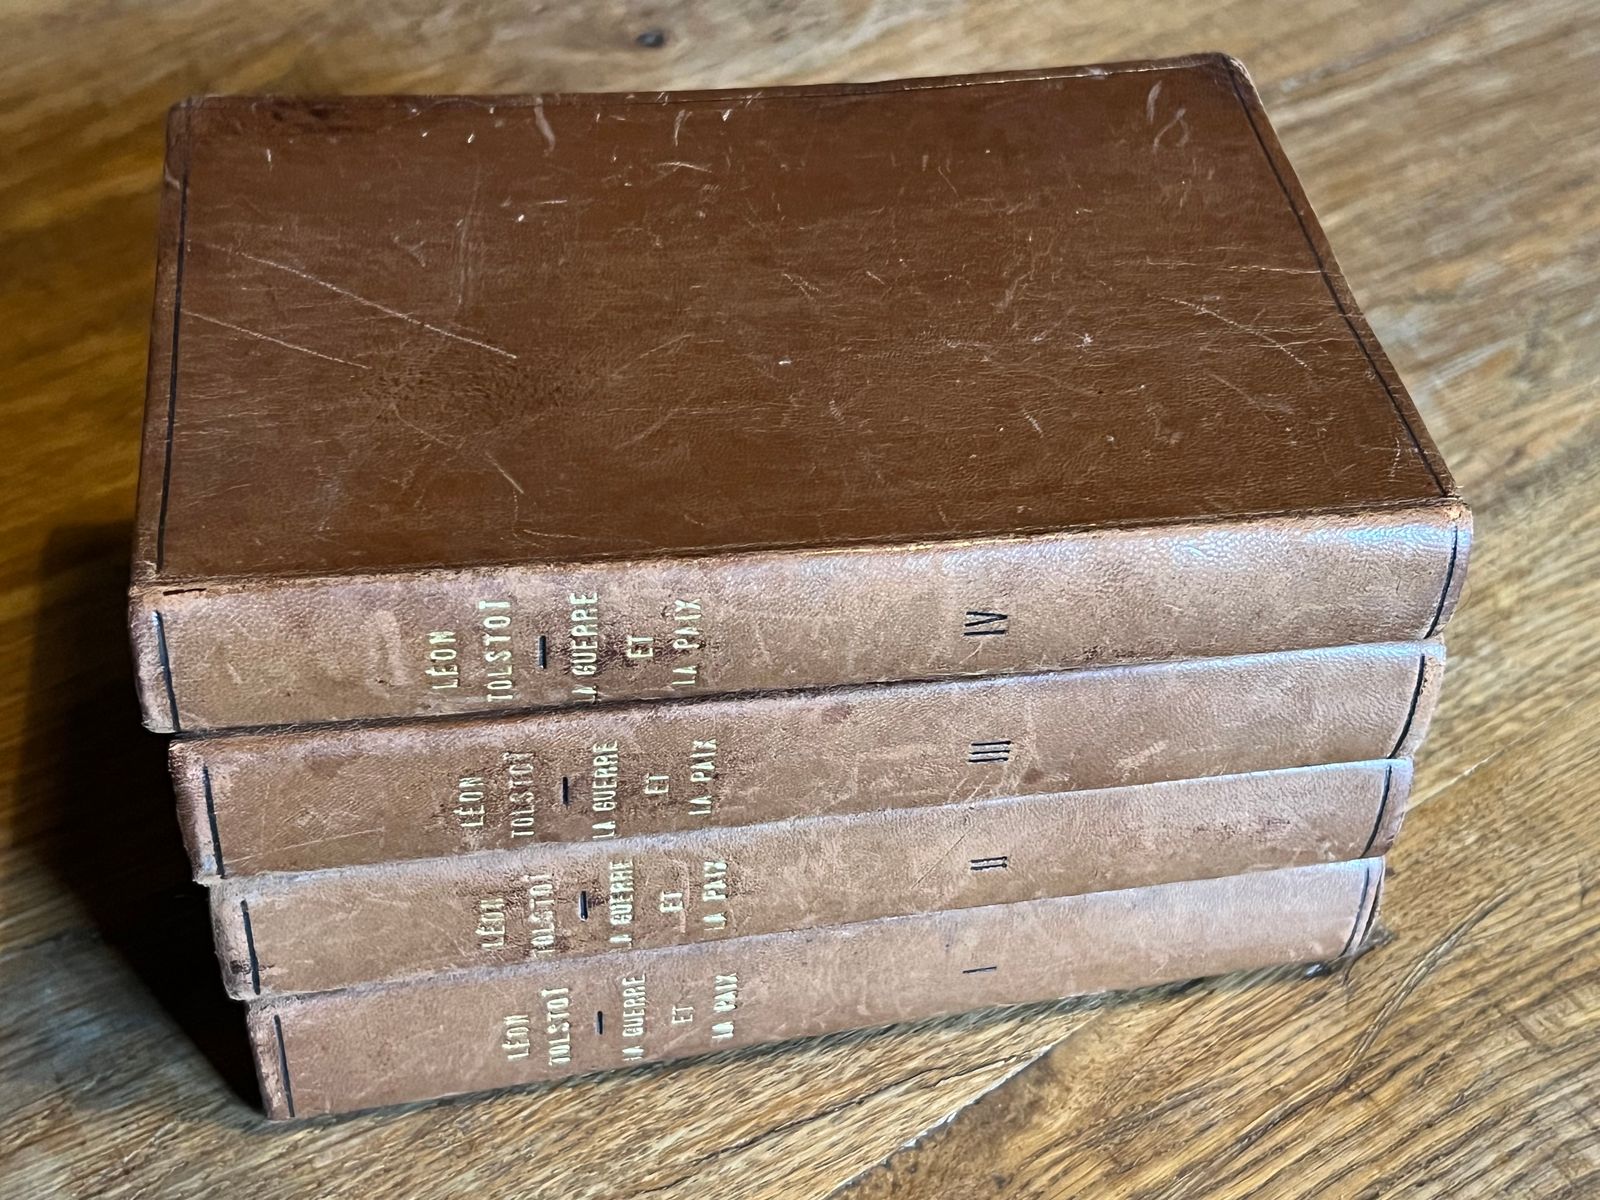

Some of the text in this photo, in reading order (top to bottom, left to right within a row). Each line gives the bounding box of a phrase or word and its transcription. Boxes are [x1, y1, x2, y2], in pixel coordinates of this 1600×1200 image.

[569, 592, 599, 703] LA GUERRE
[626, 635, 654, 659] ET
[672, 598, 702, 686] LA PAIX
[963, 611, 1008, 636] IV
[425, 631, 459, 690] LÉON
[689, 738, 717, 816] LA PAIX
[968, 740, 1011, 763] III
[453, 776, 485, 828] LÉON
[592, 739, 619, 840] LA GUERRE
[645, 773, 670, 795] ET
[970, 855, 1008, 871] II
[609, 859, 634, 950] LA GUERRE
[659, 890, 683, 914] ET
[702, 861, 729, 931] LA PAIX
[475, 898, 505, 949] LÉON
[621, 973, 647, 1062] LA GUERRE
[671, 1004, 694, 1025] ET
[711, 972, 738, 1040] LA PAIX
[501, 1014, 530, 1061] LÉON
